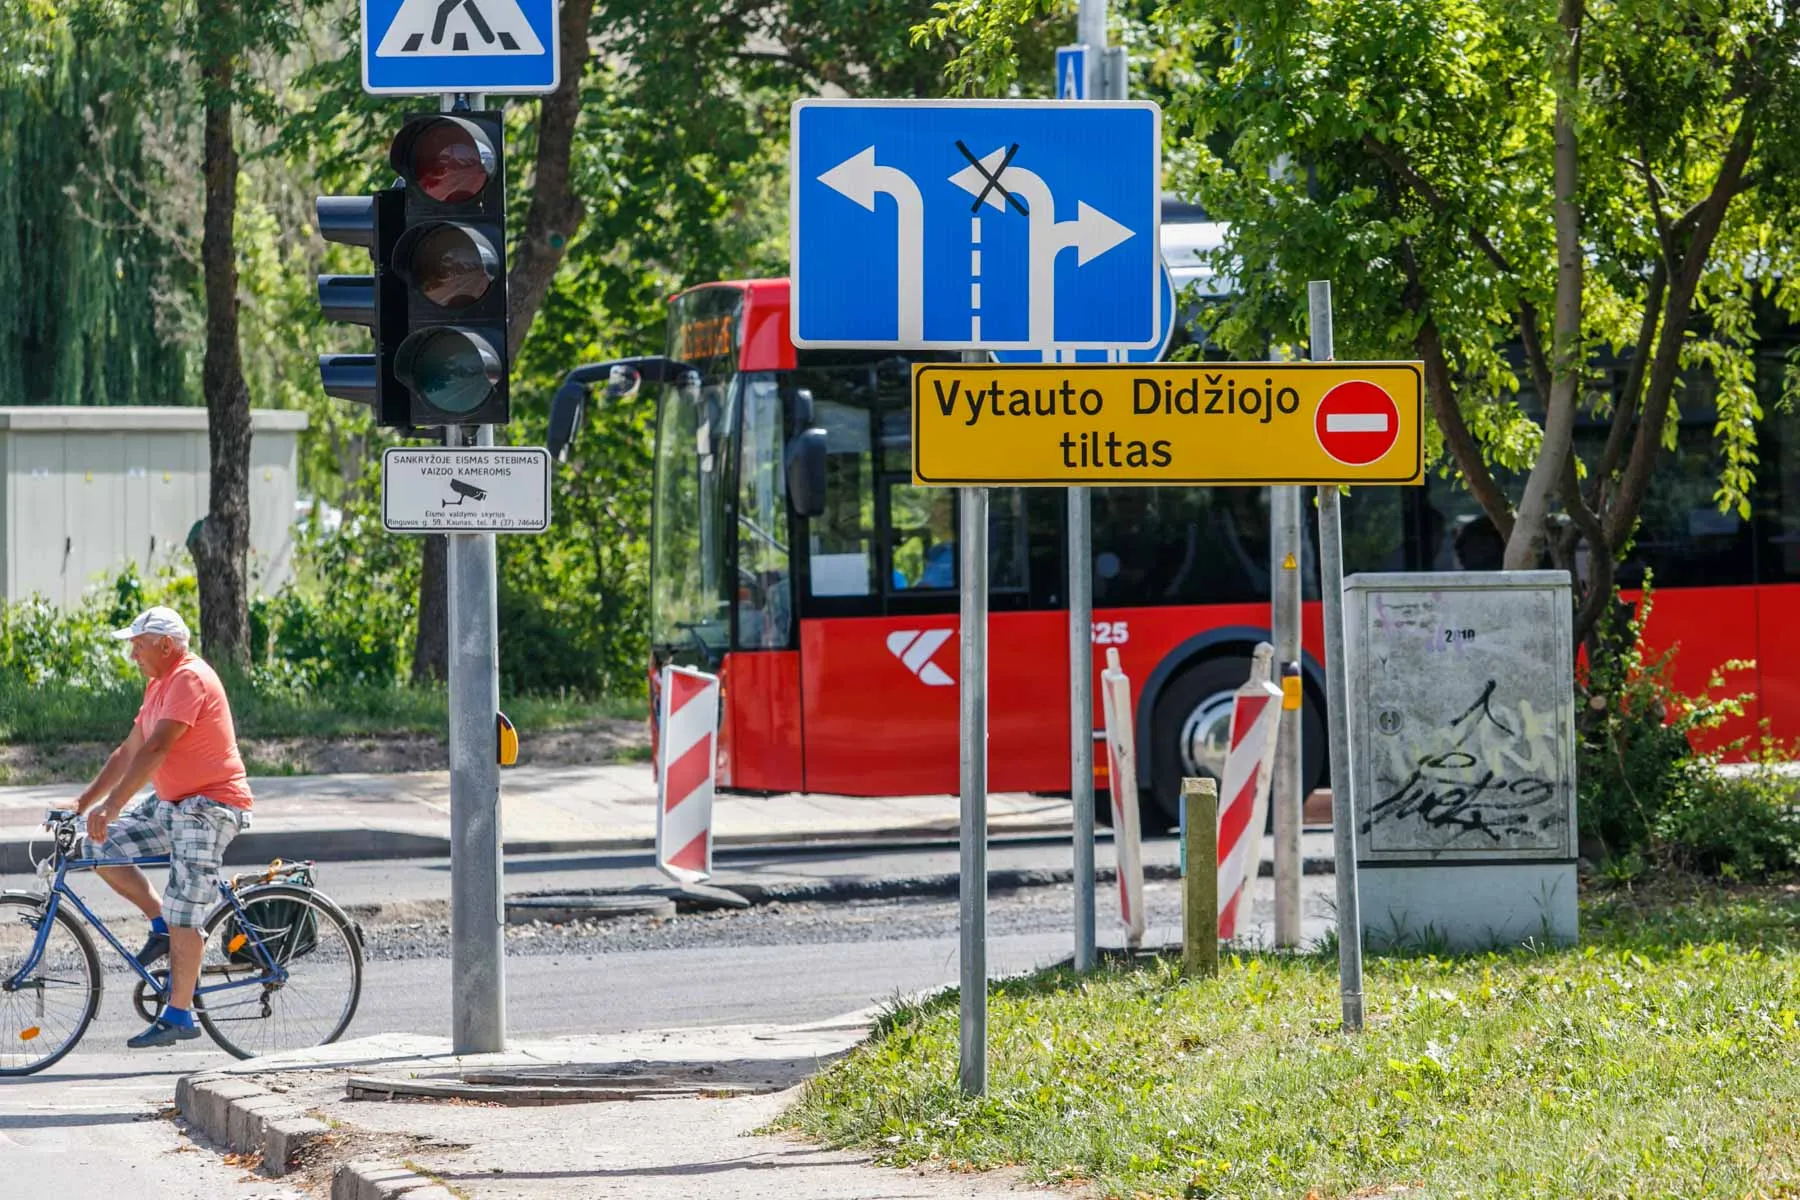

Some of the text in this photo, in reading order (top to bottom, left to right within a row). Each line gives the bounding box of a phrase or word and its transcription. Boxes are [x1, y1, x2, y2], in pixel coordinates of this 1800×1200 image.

[933, 374, 1300, 426] Vytauto Didžiojo
[393, 454, 539, 465] SANKRYŽOJE EISMAS STEBIMAS
[1060, 431, 1172, 468] tiltas
[421, 467, 511, 476] VAIZDO KAMEROMIS
